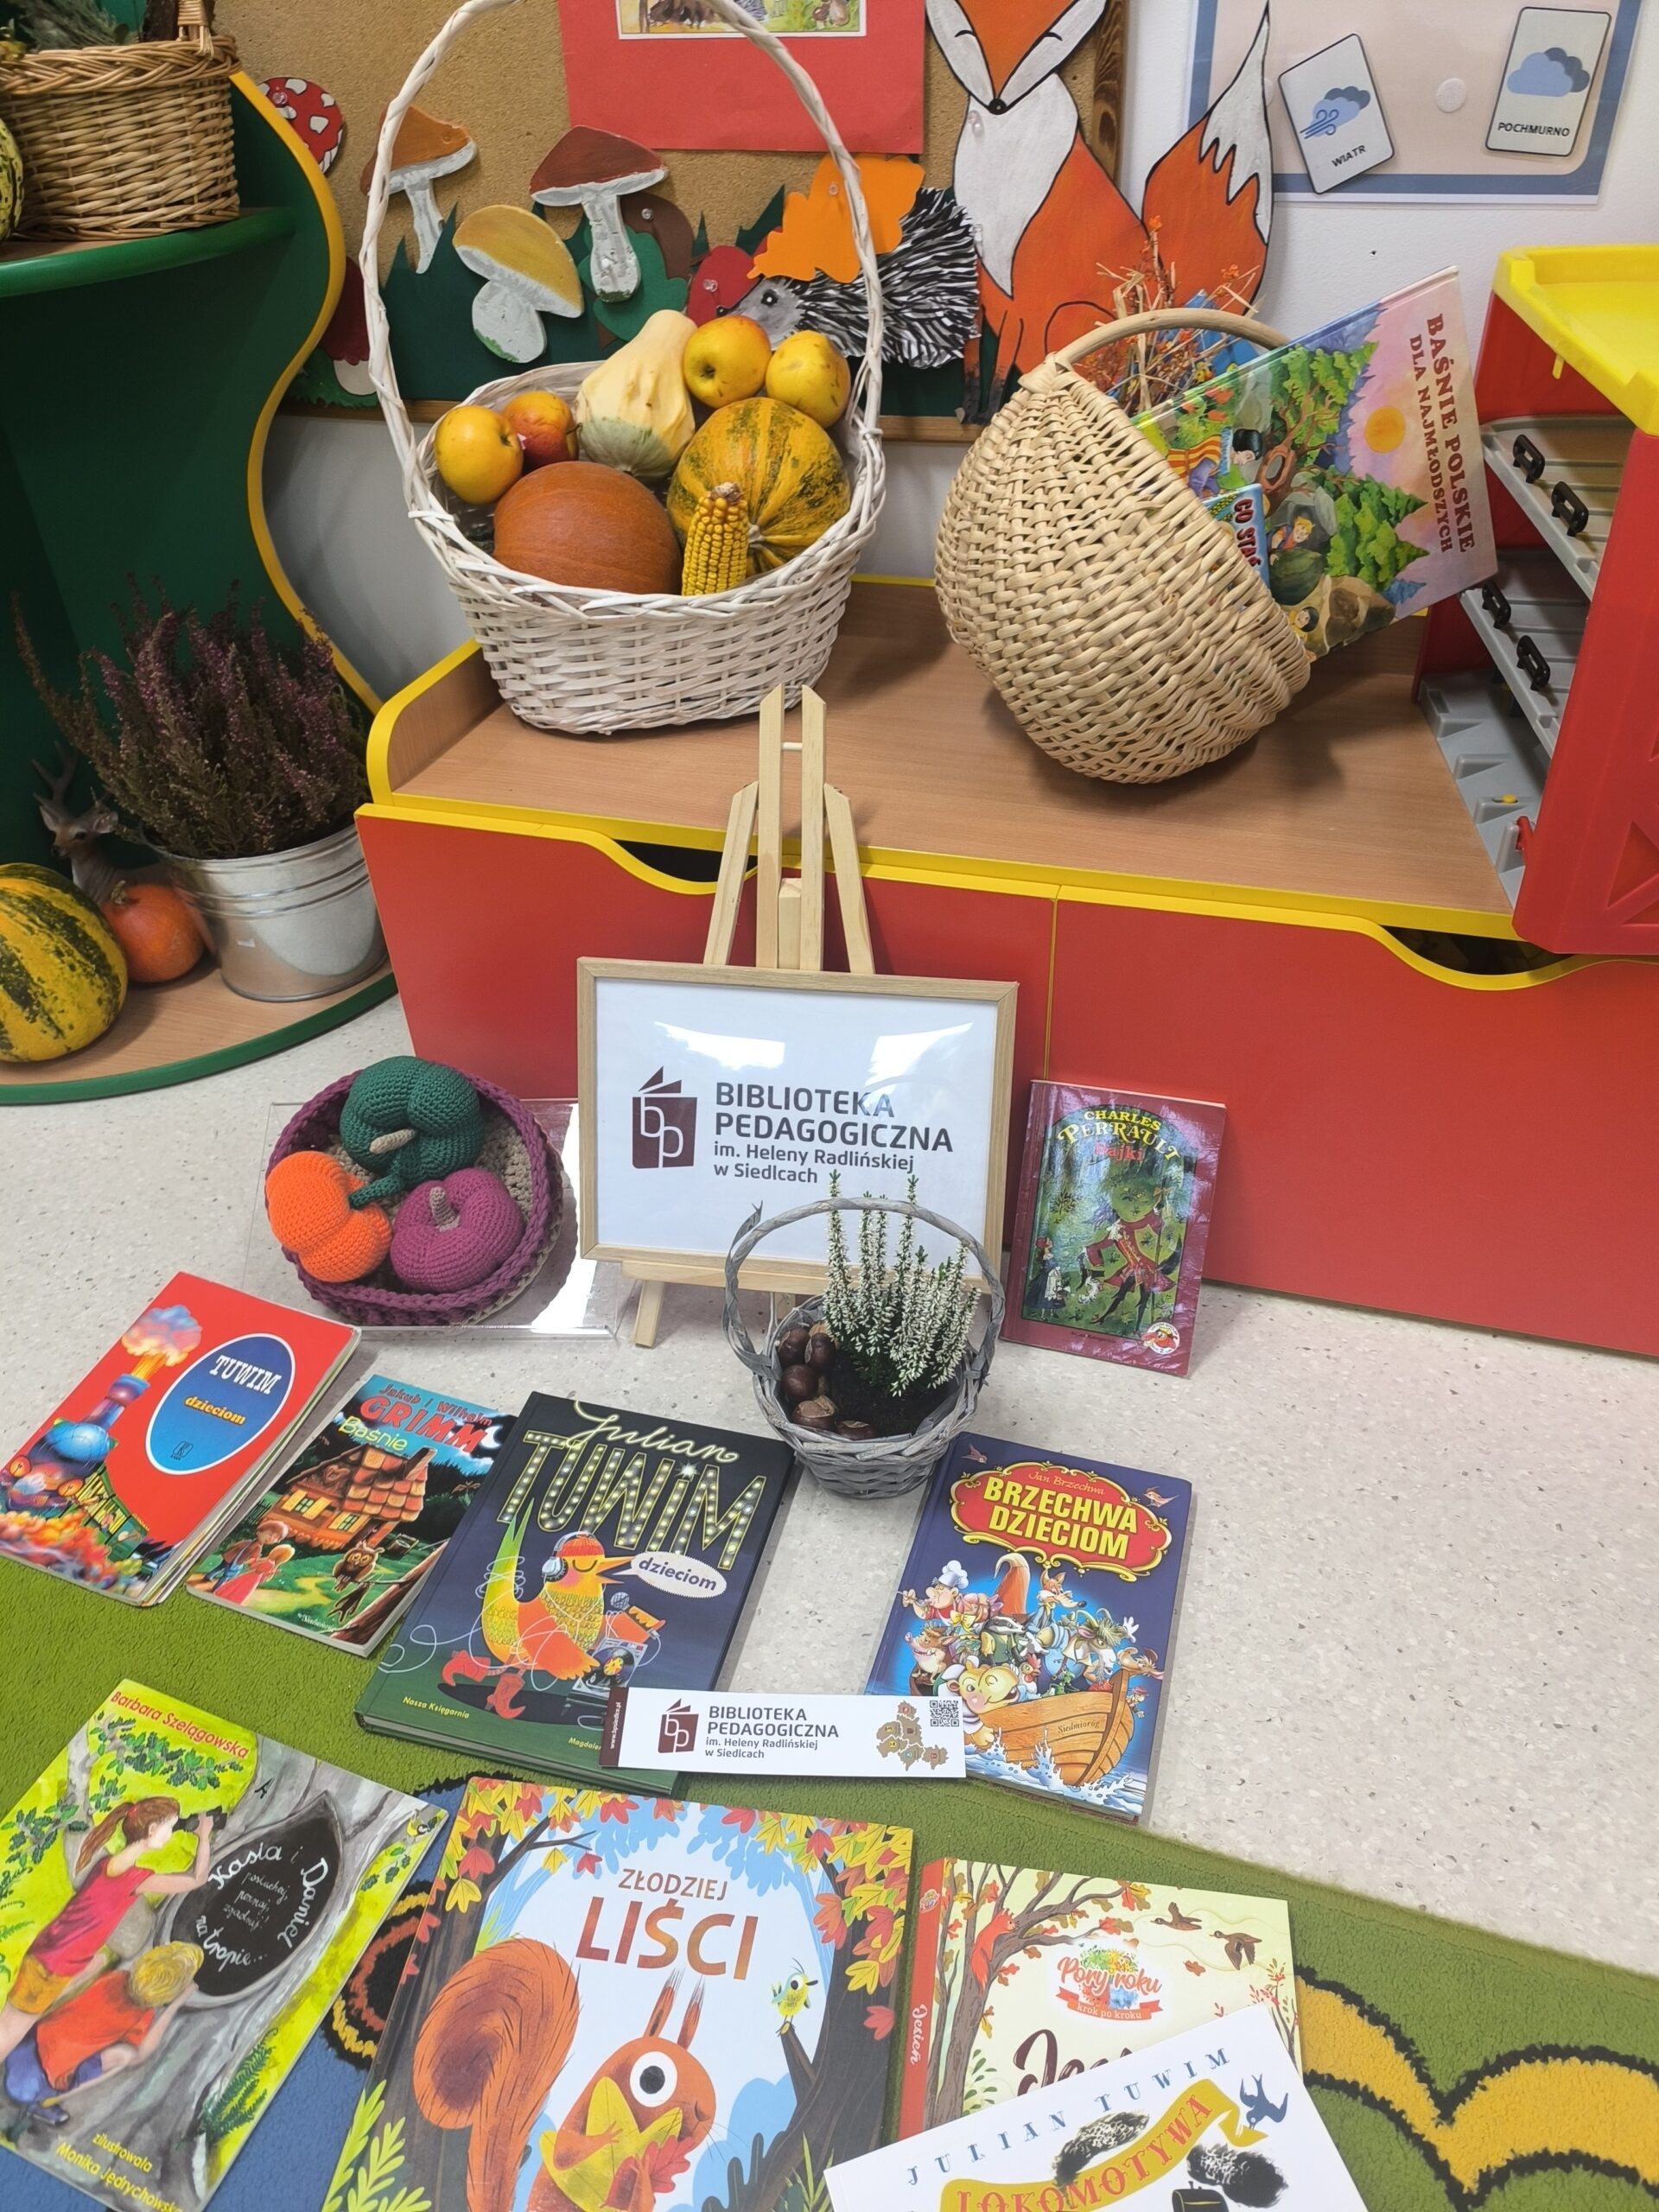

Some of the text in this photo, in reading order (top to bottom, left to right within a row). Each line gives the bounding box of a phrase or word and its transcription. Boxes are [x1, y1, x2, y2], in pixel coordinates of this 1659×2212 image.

[1497, 123, 1570, 137] POCHMURNO
[1332, 145, 1366, 168] WIATR
[1409, 334, 1453, 553] DLA NAJMŁODSZYCH
[1427, 313, 1475, 553] BAŚNIE POLSKIE
[715, 1082, 895, 1118] BIBLIOTEKA
[715, 1112, 953, 1153] PEDAGOGICZNA
[1084, 1109, 1161, 1131] CHARLES
[714, 1141, 914, 1174] im. Heleny Radlińskiej
[1057, 1122, 1181, 1160] PERRAULT
[714, 1162, 818, 1184] w Siedlcach
[209, 1355, 282, 1395] TUWIM
[183, 1395, 246, 1425] dzieciom
[379, 1384, 421, 1405] Jakub
[360, 1395, 487, 1453] GRIMM
[567, 1401, 739, 1463] Julian
[497, 1430, 767, 1571] TUWIM
[1028, 1471, 1106, 1496] Jan Brzechwa
[983, 1476, 1138, 1534] BRZECHWA
[988, 1504, 1130, 1560] DZIECIOM
[639, 1557, 718, 1592] dzieciom
[111, 1691, 250, 1759] Barbara Szelągowska
[402, 1696, 470, 1719] Nasza Księgarnia
[709, 1706, 807, 1721] BIBLIOTEKA
[706, 1737, 818, 1751] im. Heleny Radlińskiej
[707, 1721, 839, 1738] PEDAGOGICZNA
[1057, 1719, 1101, 1734] Siedmioróg
[716, 1749, 765, 1758] Siedlcach
[618, 1867, 728, 1902] ZŁODZIEJ
[575, 1894, 759, 1980] LIŚCI
[1057, 1956, 1162, 1997] Pory roku
[1077, 2001, 1142, 2019] krok po kroku
[907, 2110, 1068, 2186] JULIAN
[1096, 2047, 1230, 2113] TUWIM
[56, 2141, 101, 2175] Monika
